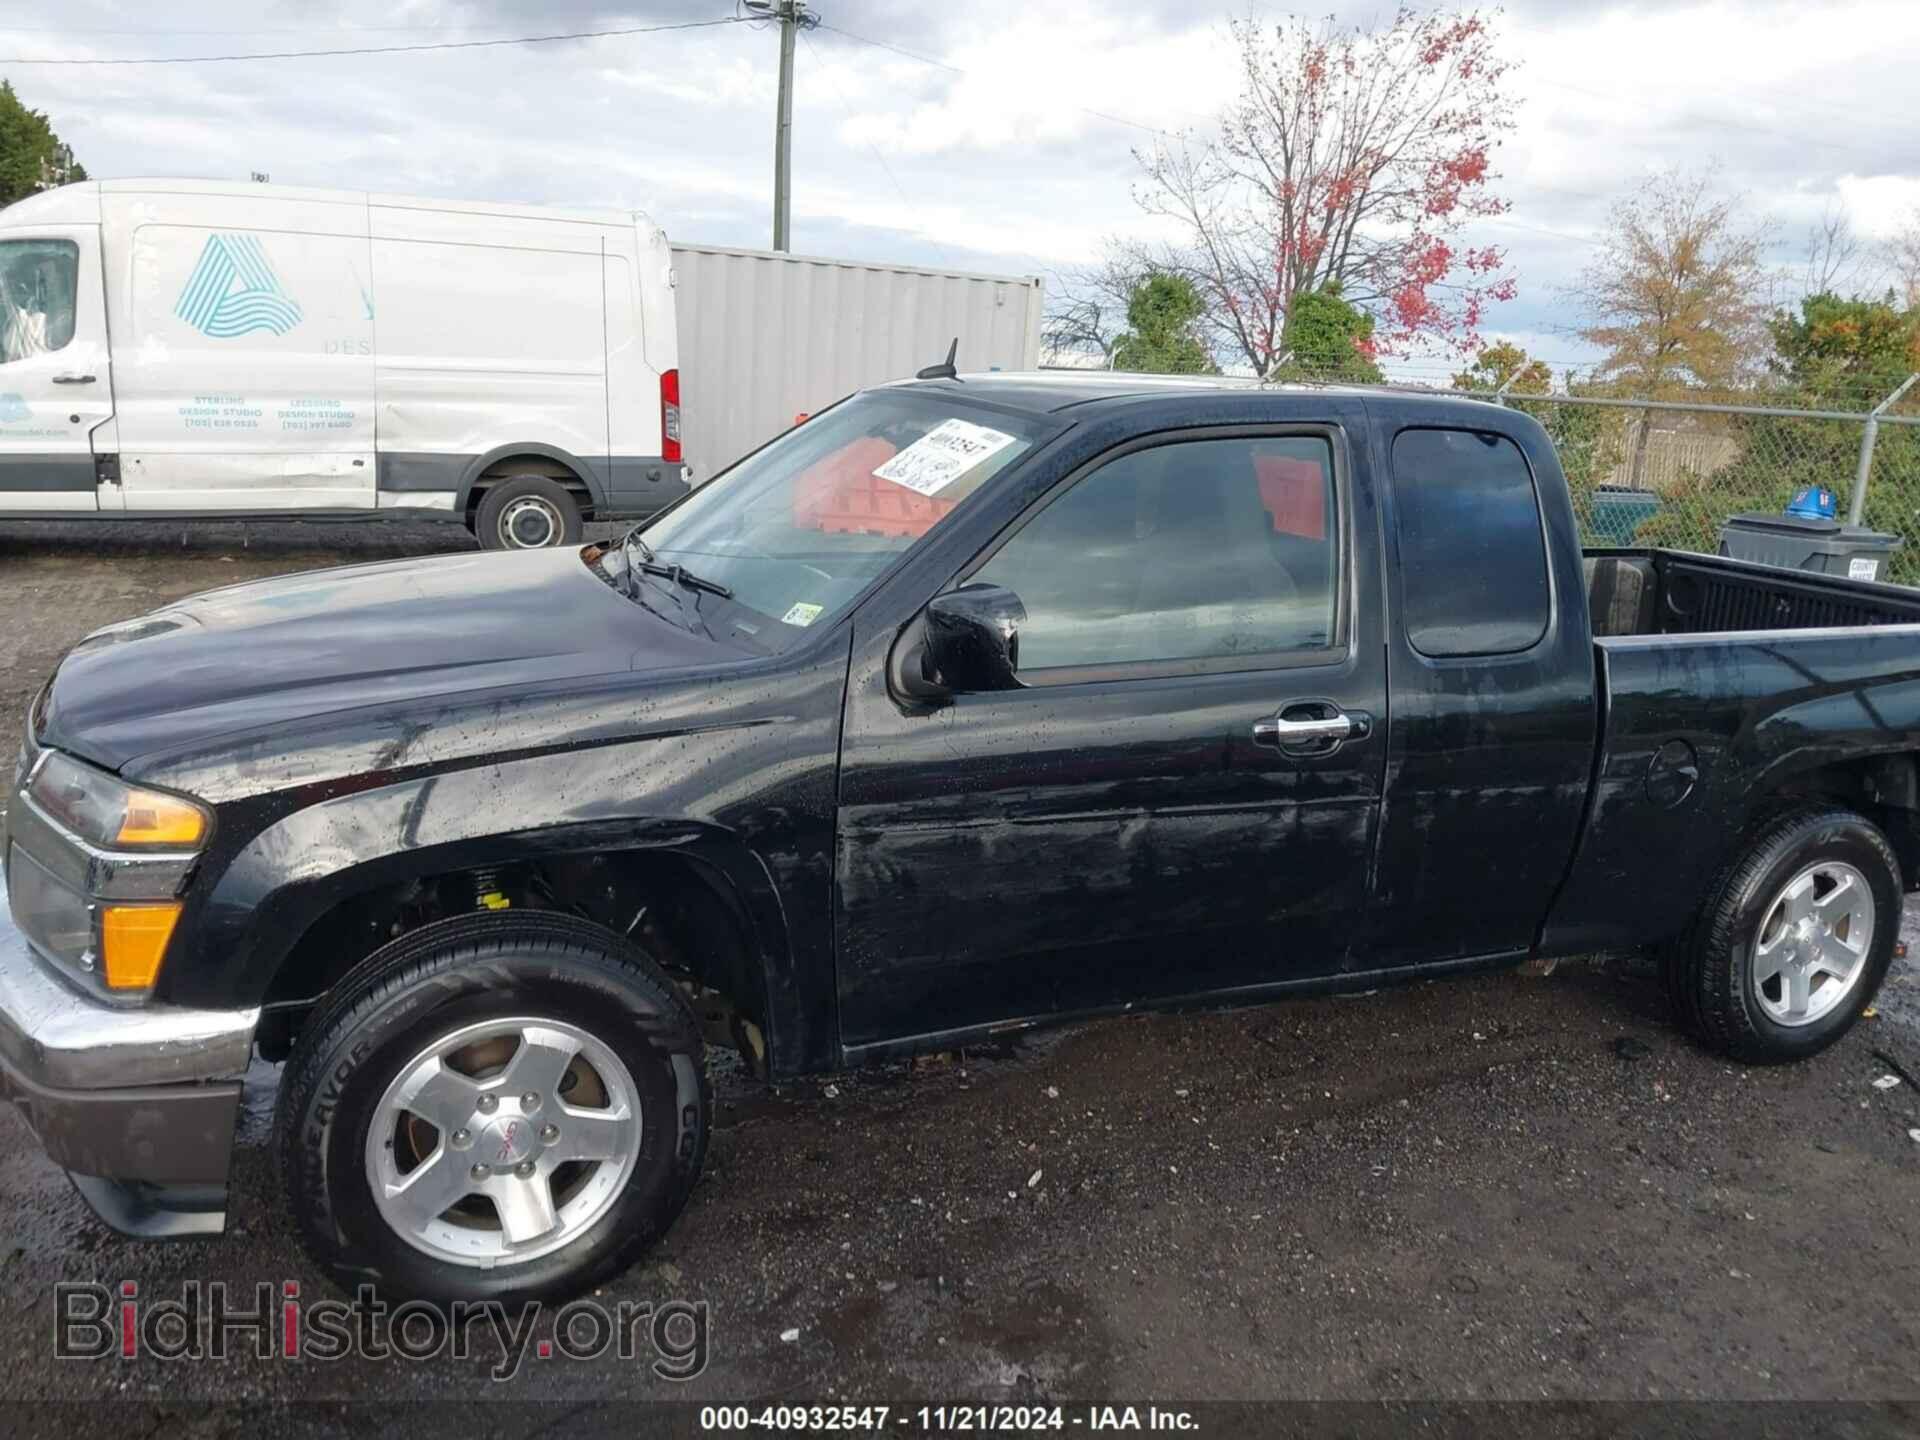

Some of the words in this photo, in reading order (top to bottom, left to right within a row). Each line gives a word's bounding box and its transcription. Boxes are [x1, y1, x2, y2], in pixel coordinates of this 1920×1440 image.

[178, 407, 219, 416] DESIGN
[223, 407, 263, 417] STUDIO
[277, 410, 316, 419] DESIGN
[318, 410, 356, 419] STUDIO
